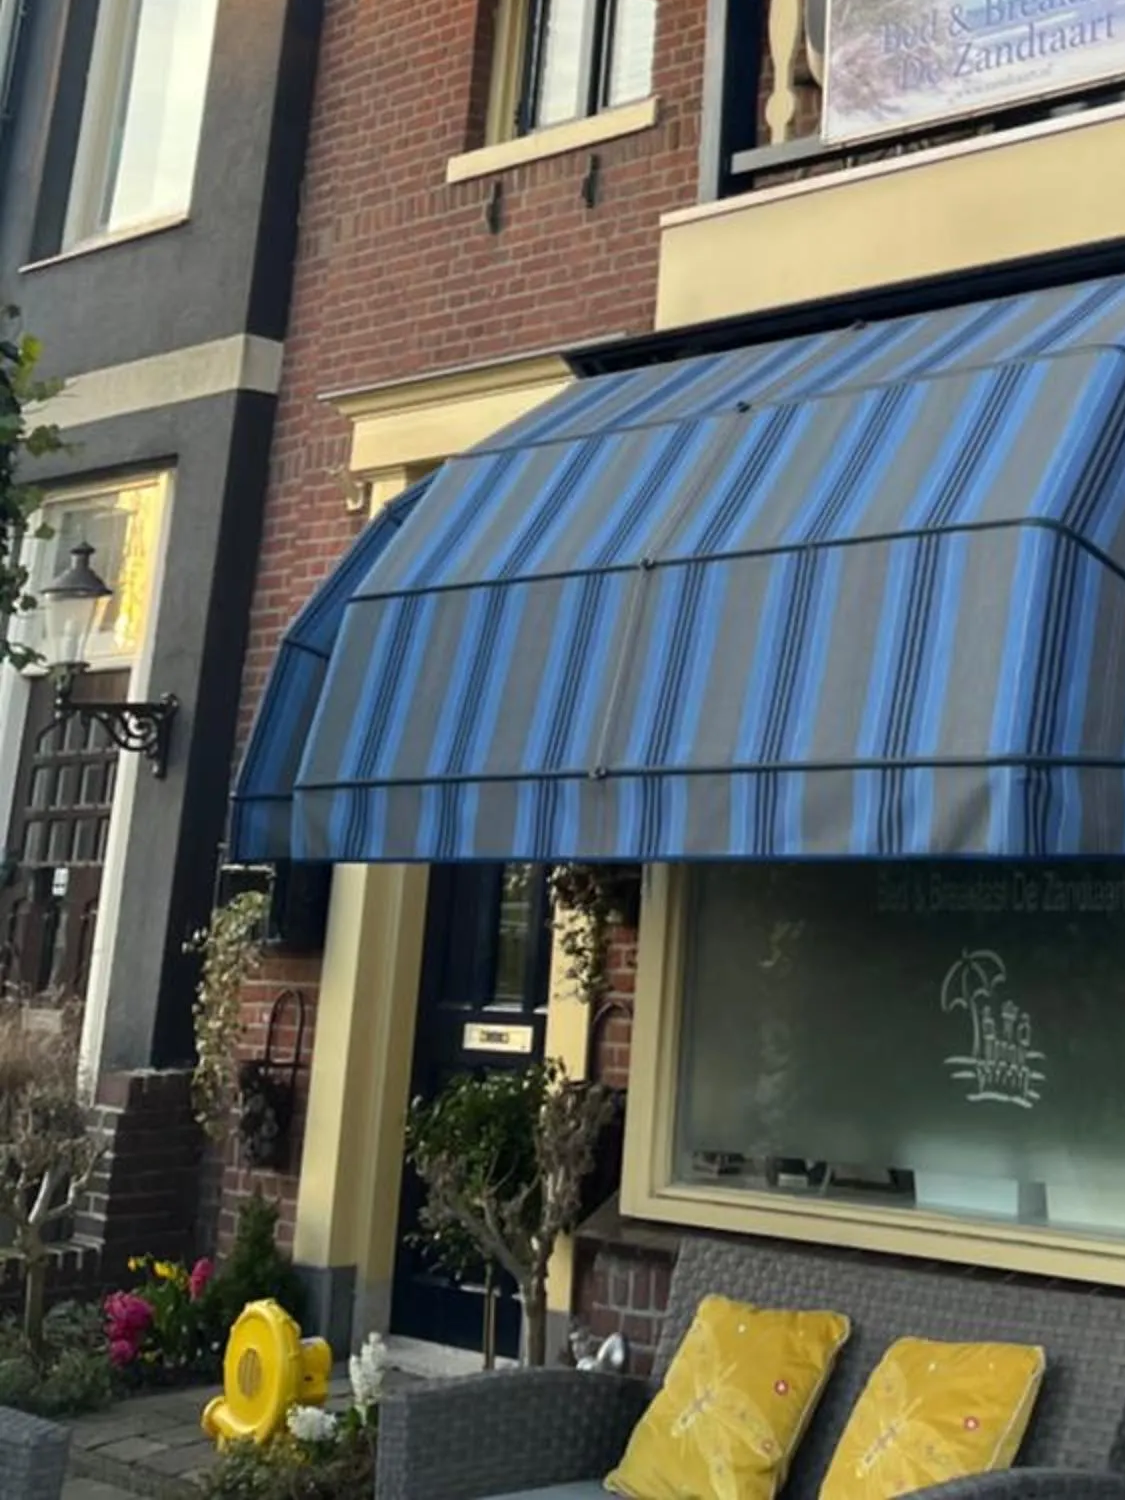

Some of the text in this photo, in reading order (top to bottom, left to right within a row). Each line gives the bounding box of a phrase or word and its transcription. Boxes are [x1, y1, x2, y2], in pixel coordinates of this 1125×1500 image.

[882, 8, 938, 53] Bed
[948, 3, 972, 37] &
[901, 56, 940, 90] De
[954, 11, 1115, 78] Zandtaart
[1013, 871, 1038, 912] De
